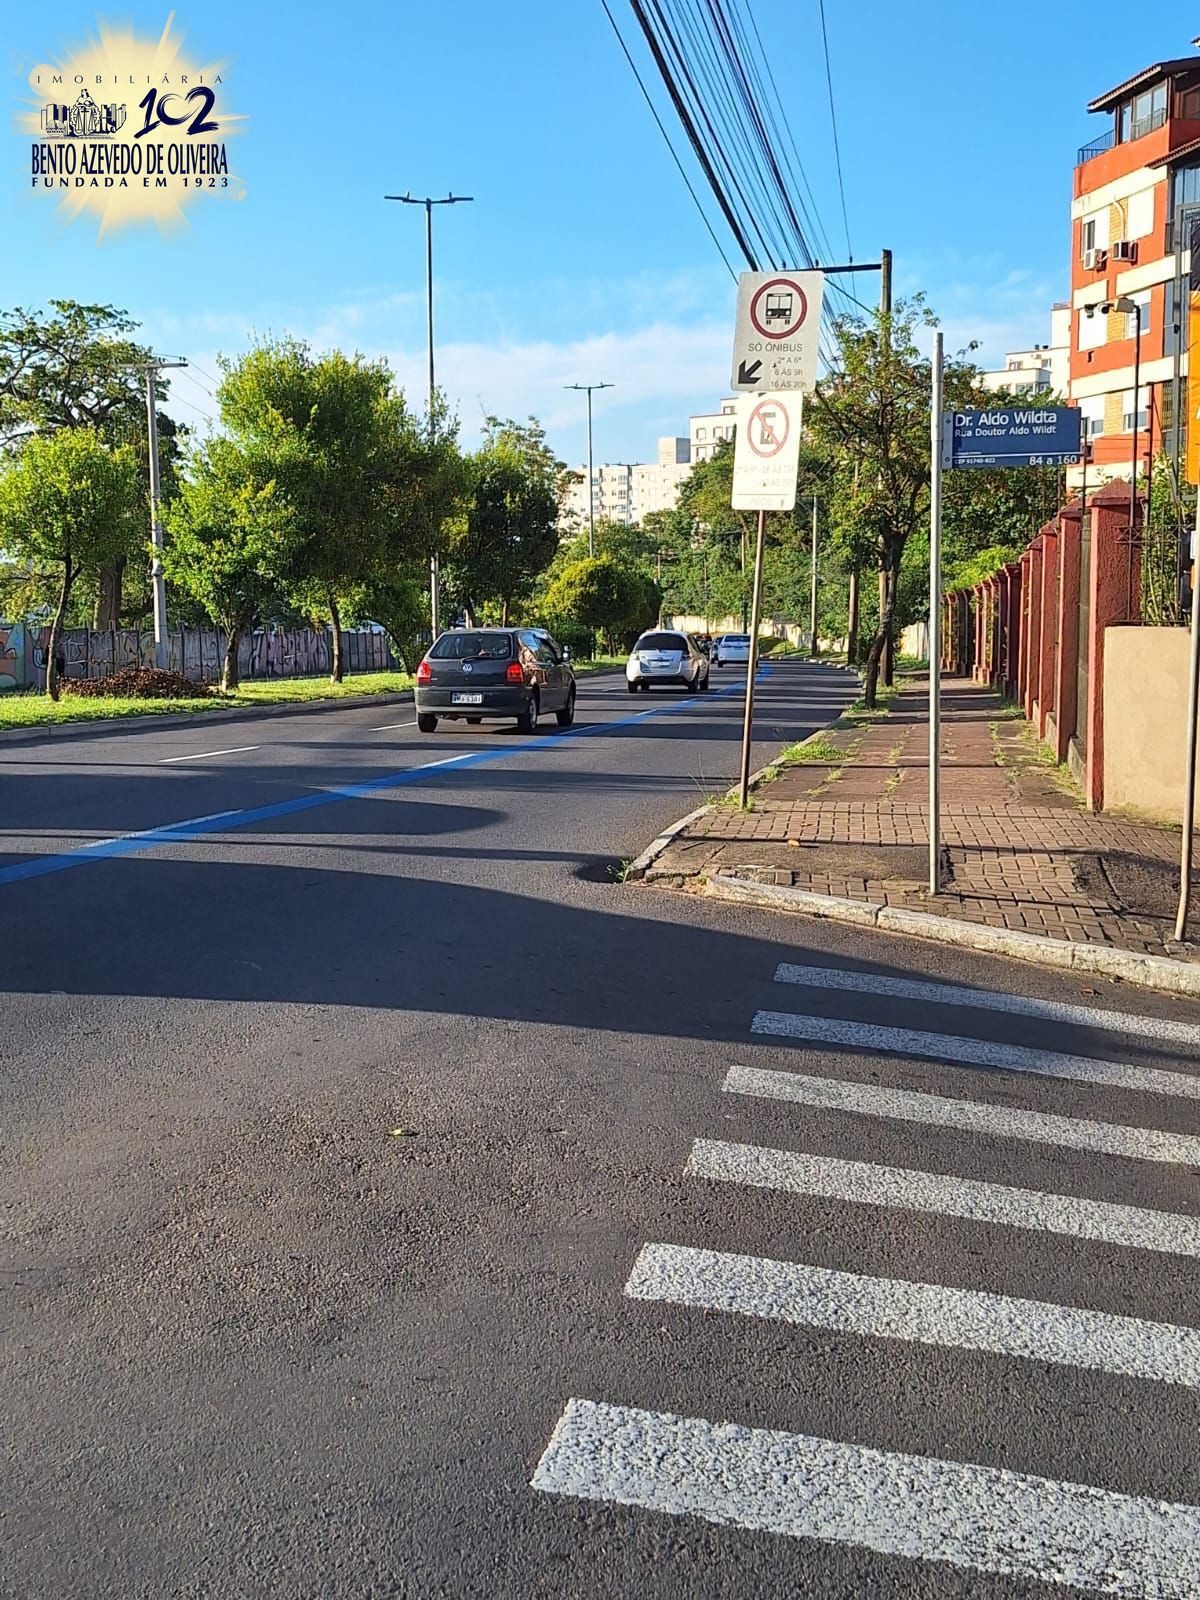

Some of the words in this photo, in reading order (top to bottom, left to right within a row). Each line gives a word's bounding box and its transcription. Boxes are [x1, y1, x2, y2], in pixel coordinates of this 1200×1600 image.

[747, 341, 763, 352] SÓ
[764, 341, 803, 352] ÔNIBUS
[954, 414, 973, 427] Dr.
[978, 412, 1009, 425] Aldo
[1014, 410, 1057, 424] Wildta
[955, 429, 972, 437] Rua
[975, 427, 1006, 436] Doutor
[1009, 426, 1030, 435] Aldo
[1033, 425, 1057, 434] Wildt
[1029, 456, 1043, 466] 84
[1057, 455, 1077, 465] 160
